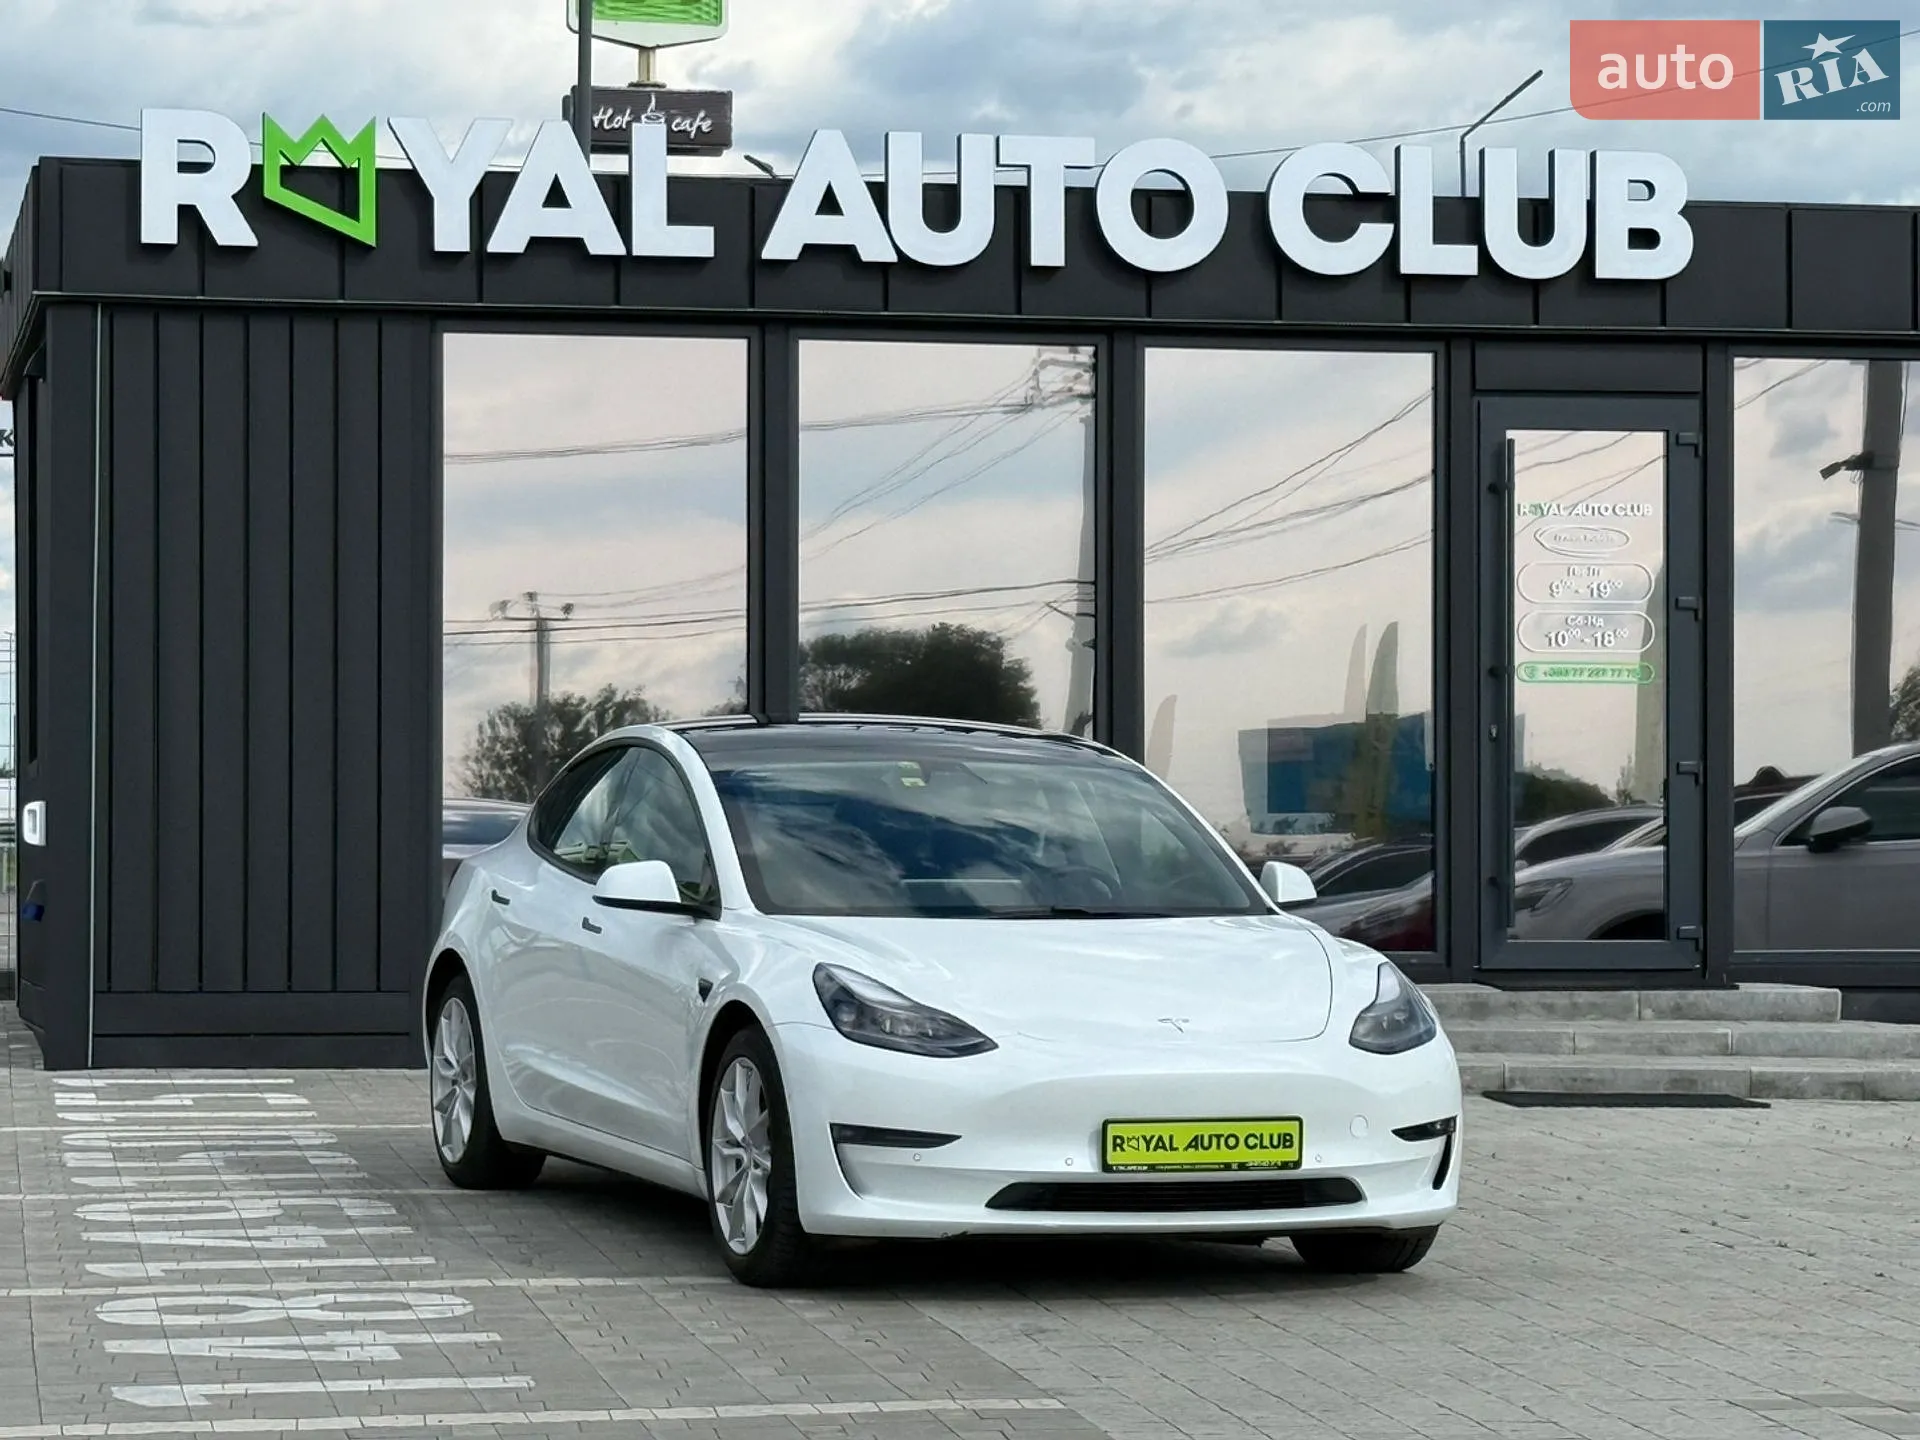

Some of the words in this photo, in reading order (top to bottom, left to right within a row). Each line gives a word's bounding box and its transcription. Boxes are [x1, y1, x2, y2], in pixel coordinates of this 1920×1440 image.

[592, 106, 634, 130] Hot
[671, 111, 713, 139] cafe
[761, 128, 1229, 273] AUTO
[1268, 142, 1694, 280] CLUB
[1571, 503, 1610, 516] AUTO
[1612, 503, 1653, 516] CLUB
[1183, 1133, 1239, 1152] AUTO
[1244, 1132, 1294, 1150] CLUB
